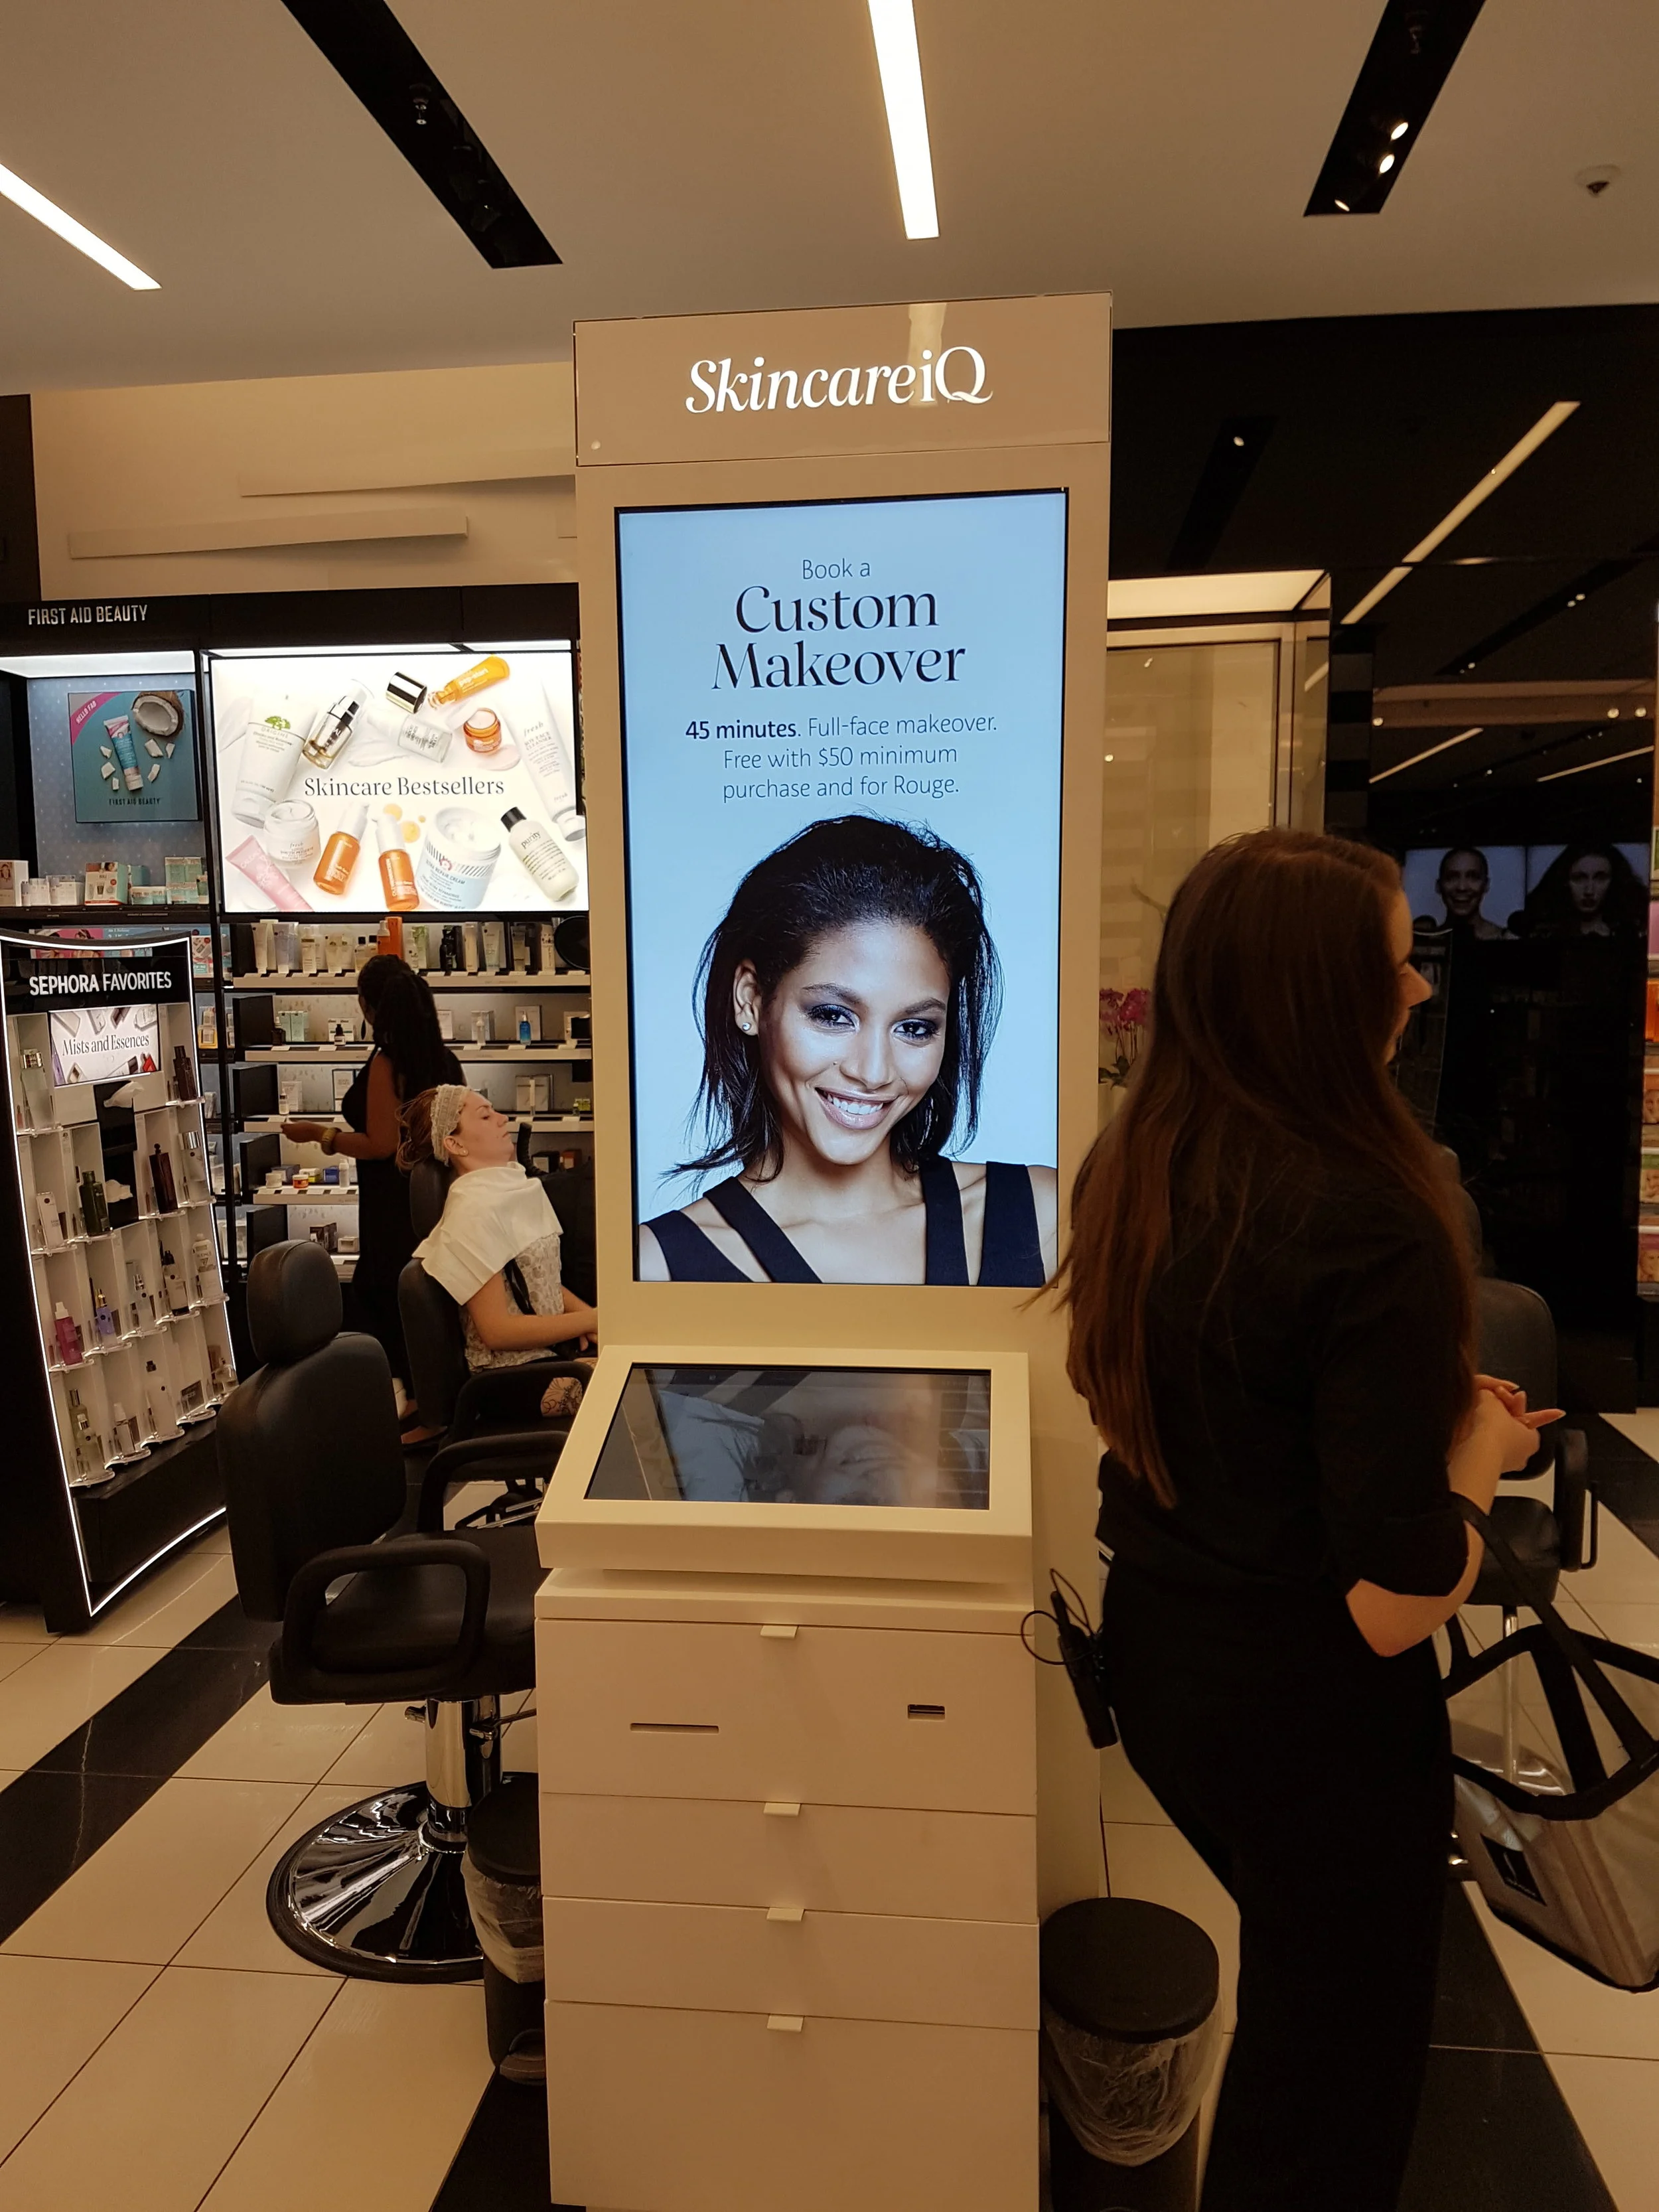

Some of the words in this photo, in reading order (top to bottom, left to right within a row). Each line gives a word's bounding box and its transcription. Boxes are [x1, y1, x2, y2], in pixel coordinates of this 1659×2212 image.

[685, 346, 993, 413] SkincareiQ
[802, 558, 853, 579] Book
[860, 562, 871, 577] a
[28, 607, 66, 625] FIRST
[70, 607, 92, 624] AID
[96, 605, 147, 623] BEAUTY
[736, 585, 940, 633] Custom
[711, 640, 966, 690] Makeover
[524, 721, 543, 737] fresh
[685, 720, 709, 739] 45
[717, 719, 801, 739] minutes.
[809, 716, 889, 737] Full-face
[897, 713, 997, 734] makeover.
[724, 750, 761, 769] Free
[768, 748, 810, 768] with
[818, 747, 853, 767] $50
[860, 745, 957, 765] minimum
[304, 777, 392, 796] Skincare
[397, 776, 504, 796] Bestsellers
[723, 778, 810, 803] purchase
[818, 777, 852, 796] and
[861, 776, 887, 796] for
[894, 774, 959, 798] Rouge.
[521, 831, 541, 849] purity
[29, 974, 100, 995] SEPHORA
[103, 972, 172, 992] FAVORITES
[62, 1039, 90, 1057] Mists
[92, 1035, 109, 1052] and
[111, 1034, 149, 1050] Essences
